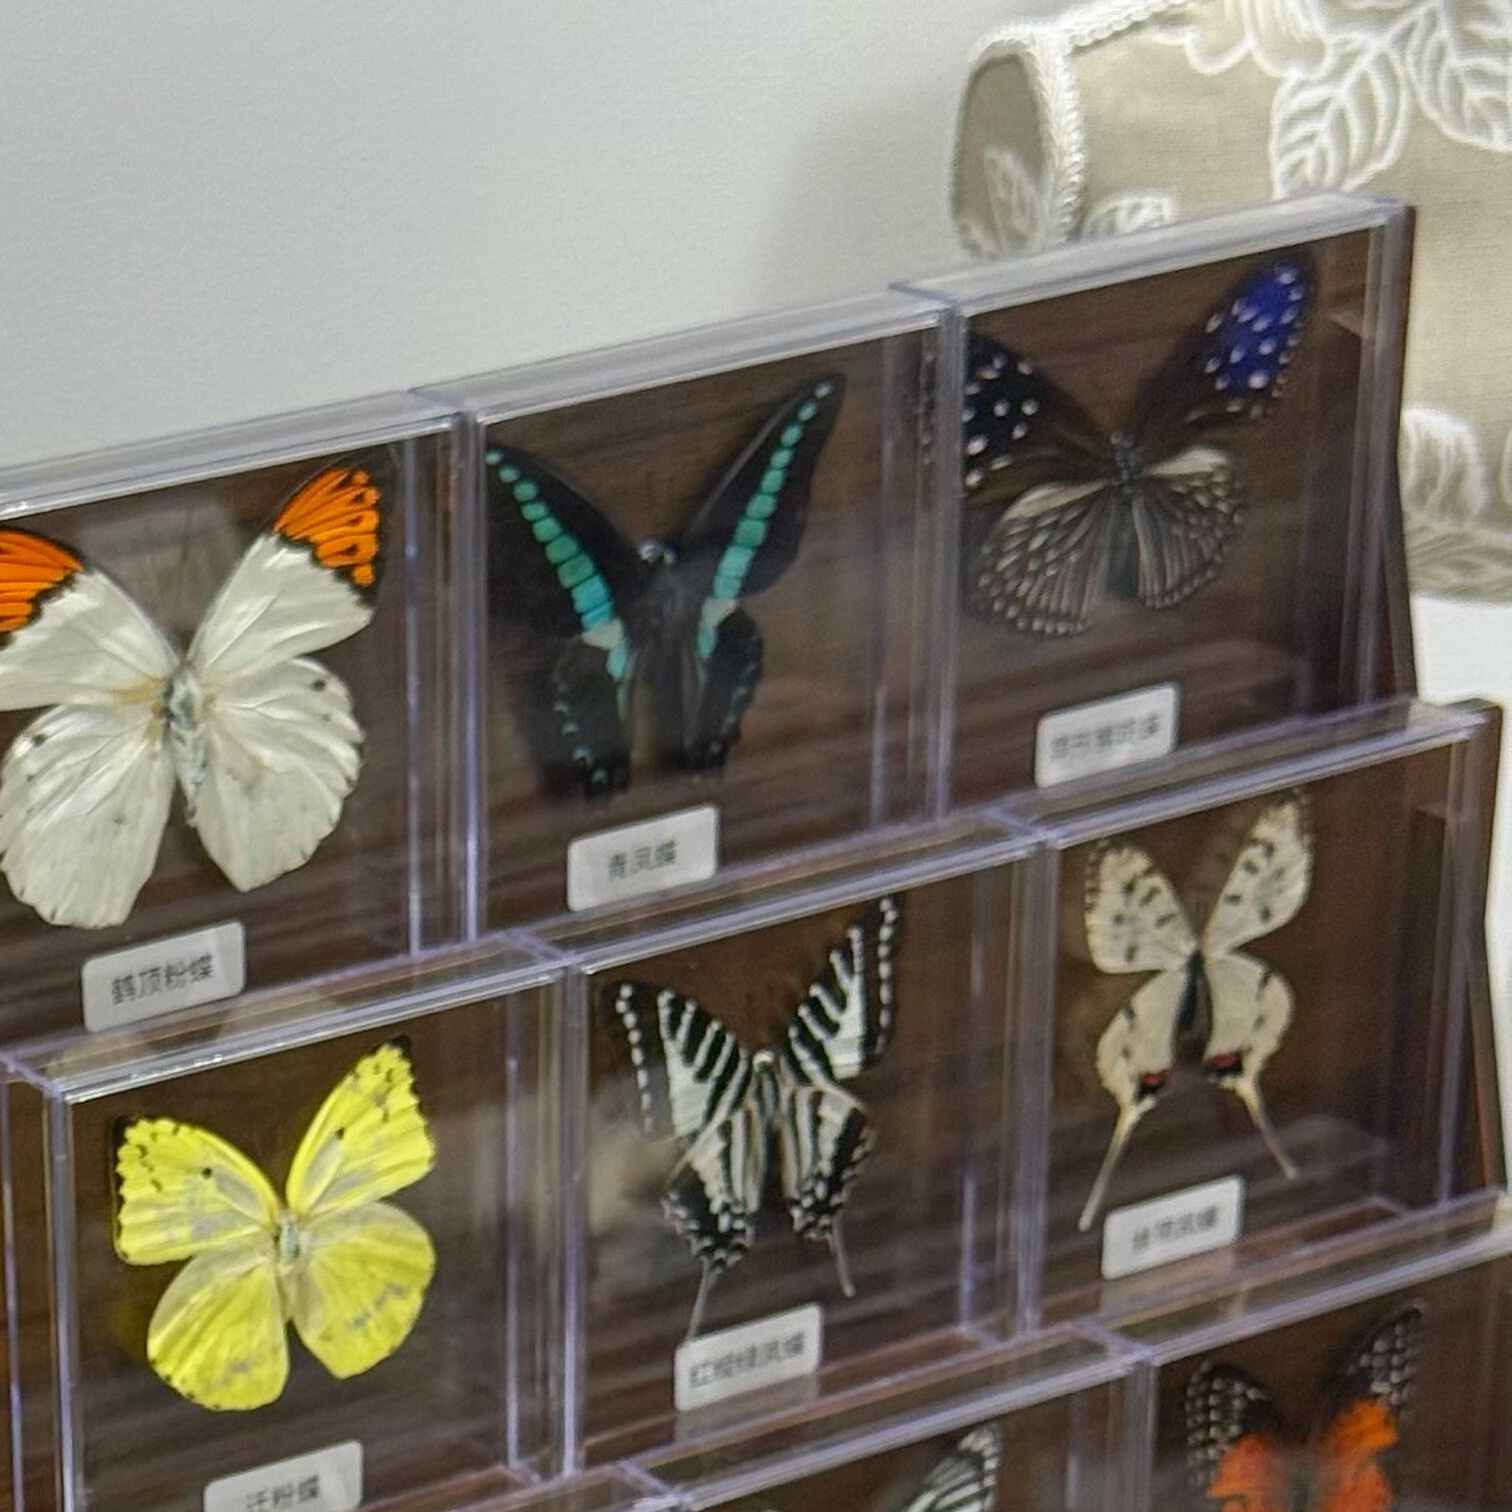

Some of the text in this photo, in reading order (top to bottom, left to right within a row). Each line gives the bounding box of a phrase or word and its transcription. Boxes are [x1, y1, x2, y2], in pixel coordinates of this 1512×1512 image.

[608, 840, 676, 881] 青凤蝶
[111, 952, 214, 1006] 鹤顶粉蝶
